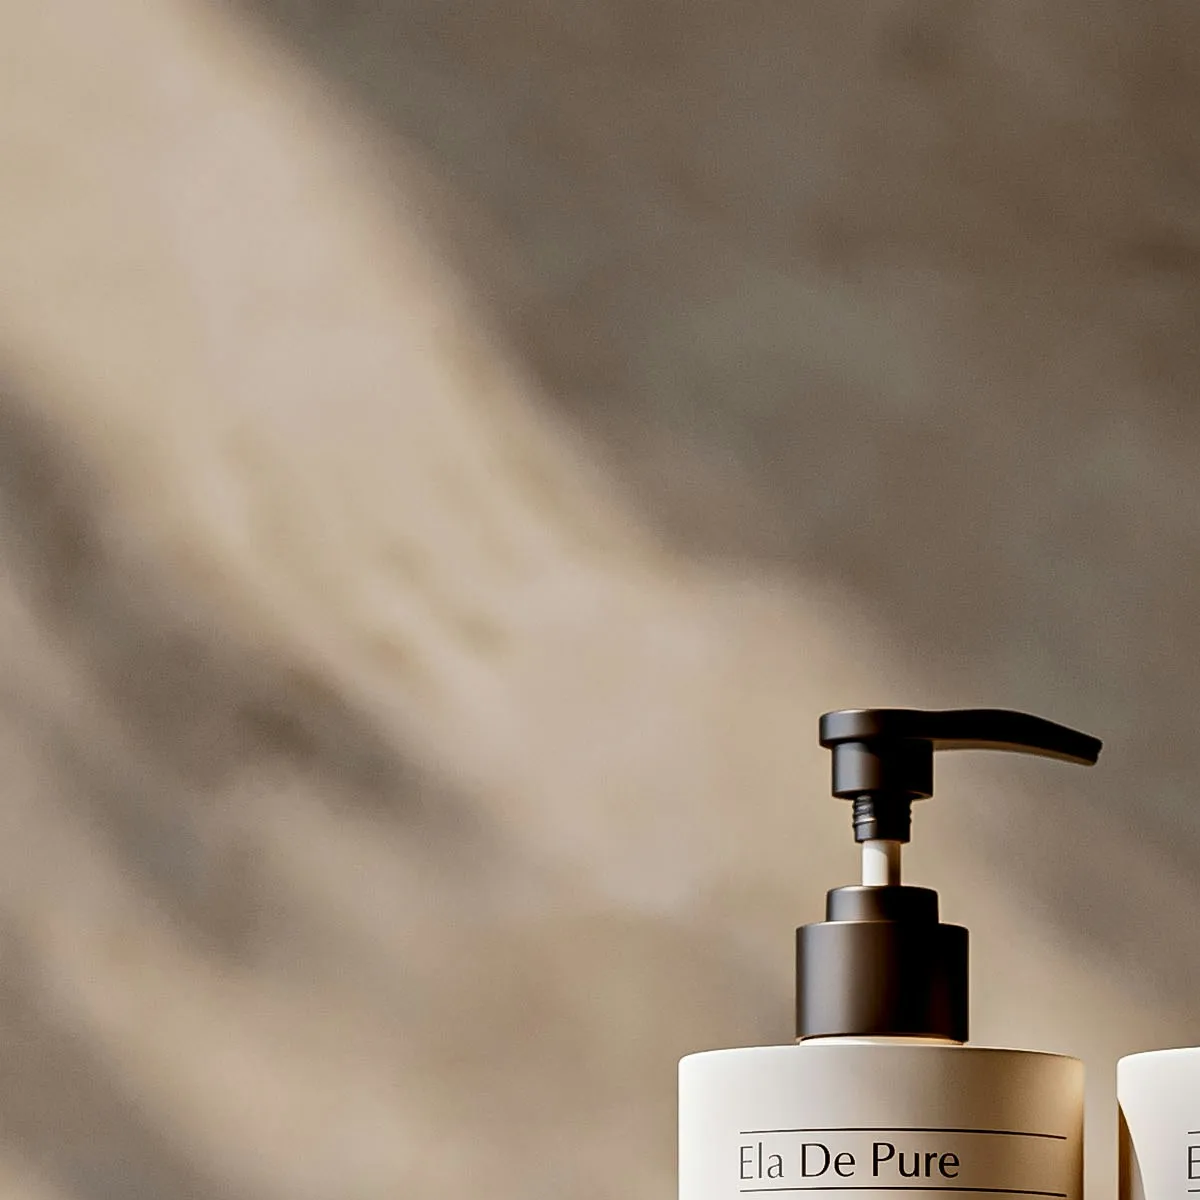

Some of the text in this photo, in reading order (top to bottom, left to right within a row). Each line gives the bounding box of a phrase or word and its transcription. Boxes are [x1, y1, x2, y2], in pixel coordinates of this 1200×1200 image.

[740, 1142, 960, 1180] Ela De Pure
